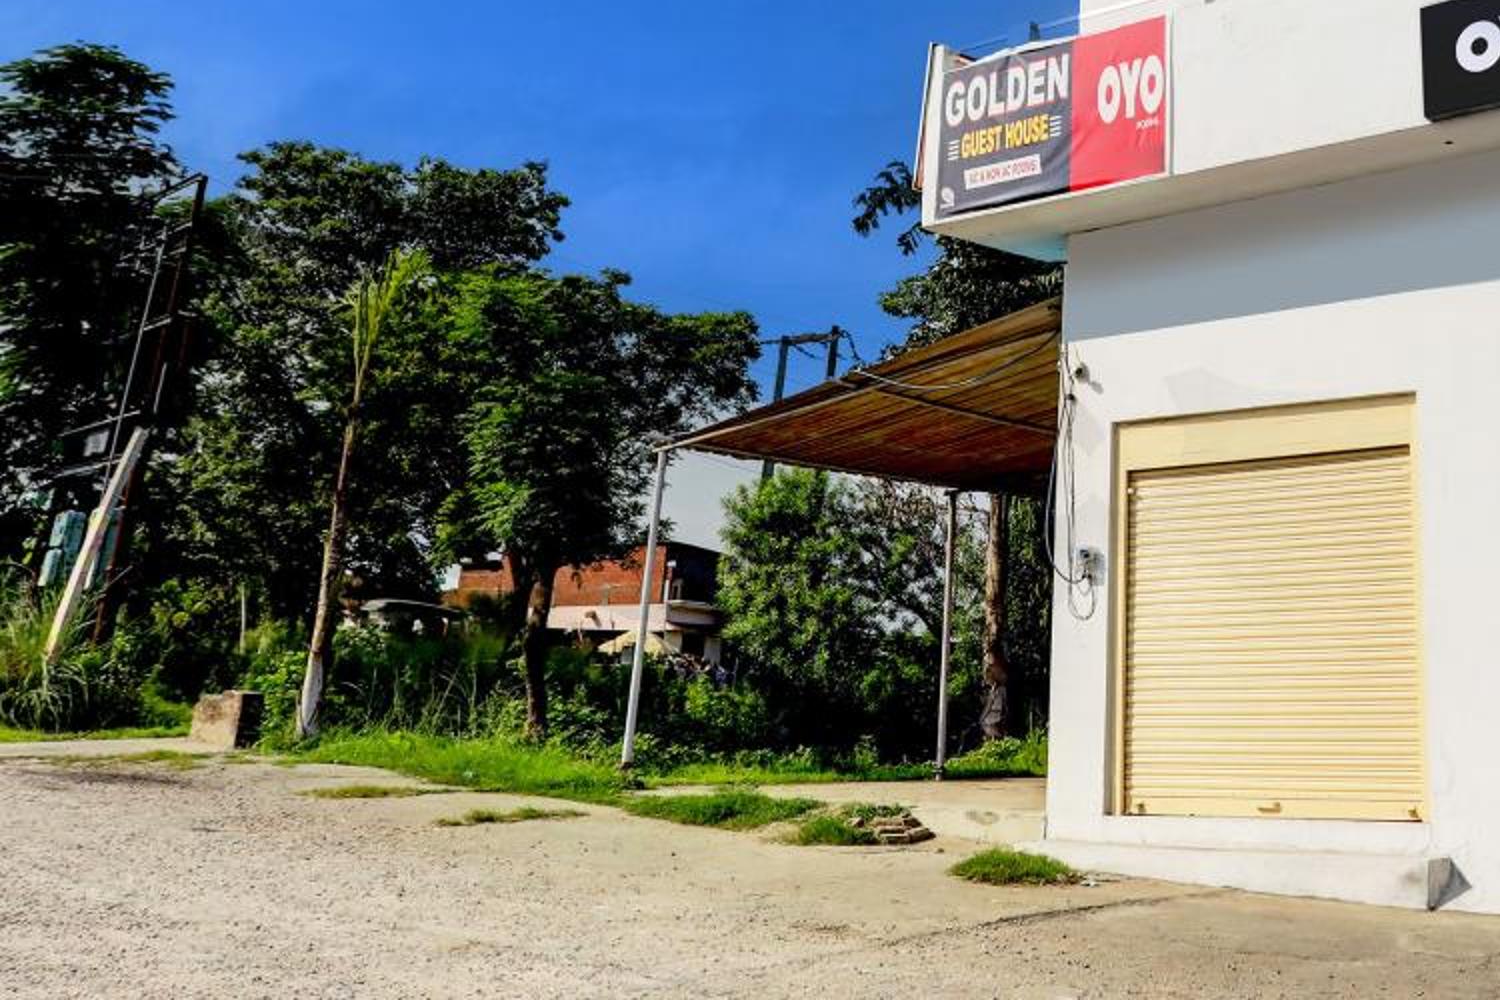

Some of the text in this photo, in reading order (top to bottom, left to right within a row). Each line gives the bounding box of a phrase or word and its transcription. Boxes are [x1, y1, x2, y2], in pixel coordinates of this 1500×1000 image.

[945, 53, 1070, 127] GOLDEN
[1096, 55, 1164, 124] OYO
[960, 113, 1050, 159] GUEST HOUSE
